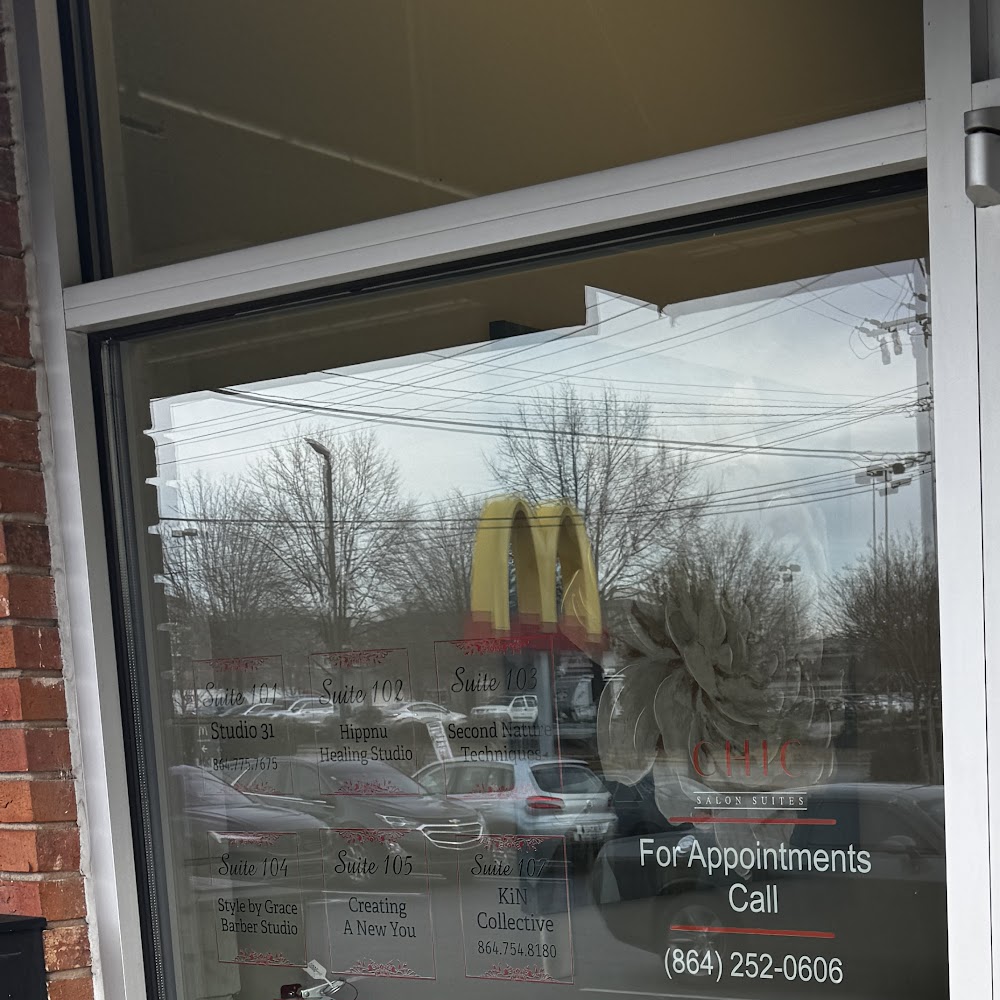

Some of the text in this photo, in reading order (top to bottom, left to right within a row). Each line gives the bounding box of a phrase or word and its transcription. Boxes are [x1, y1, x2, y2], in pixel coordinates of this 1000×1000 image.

[451, 666, 538, 693] Suite 103
[203, 682, 277, 708] Suite 101
[319, 678, 404, 705] Suite 102
[210, 720, 258, 740] Studio
[260, 723, 275, 740] 31
[340, 724, 388, 743] Hippnu
[448, 721, 553, 739] Second Nature
[320, 745, 413, 766] Healing Studio
[460, 745, 542, 766] Techniques
[692, 739, 801, 778] CHIC
[696, 796, 805, 806] SALON SUITES
[218, 853, 288, 877] Suite 104
[334, 849, 413, 875] Suite 105
[471, 853, 547, 877] Suite 107
[639, 838, 872, 876] For Appointments
[217, 897, 298, 916] Style by Grace
[498, 887, 528, 905] KiN
[728, 883, 778, 914] Call
[348, 896, 407, 918] Creating
[220, 918, 298, 935] Barber Studio
[343, 920, 417, 938] A New You
[477, 911, 554, 932] Collective
[477, 941, 557, 958] 864.754.8180
[664, 948, 844, 984] (864) 252-0606
